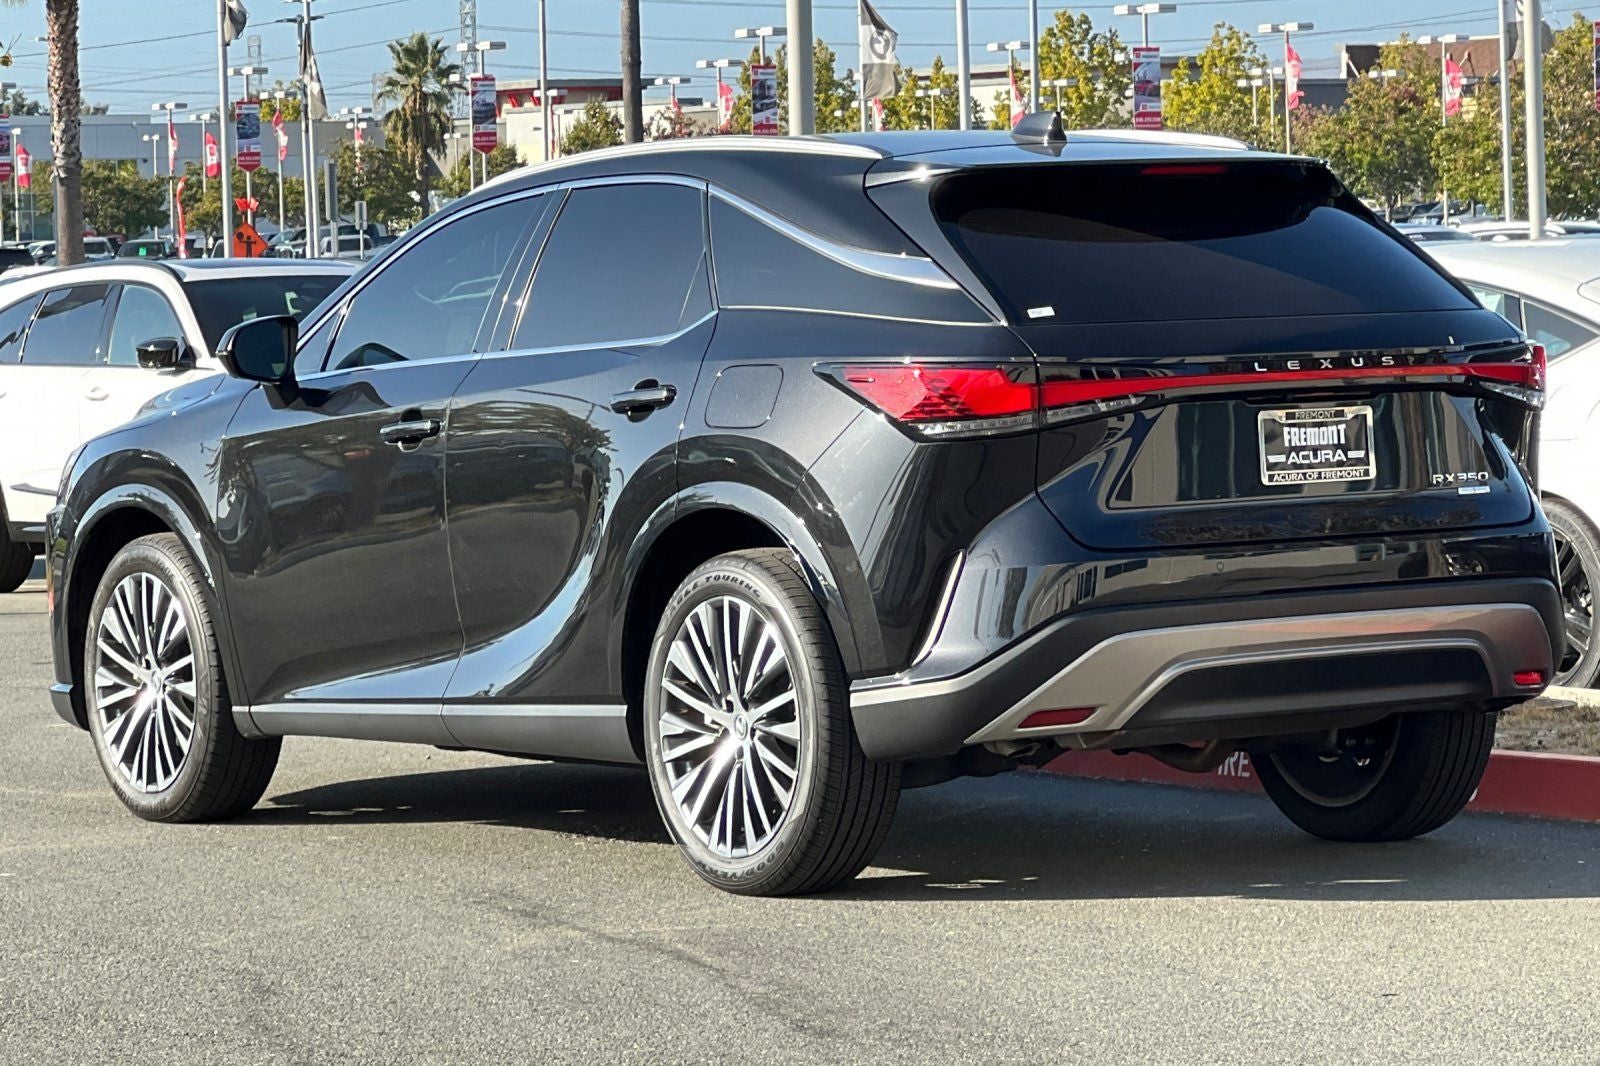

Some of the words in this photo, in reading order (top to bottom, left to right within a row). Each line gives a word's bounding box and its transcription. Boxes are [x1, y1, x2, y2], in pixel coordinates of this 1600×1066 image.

[1254, 356, 1395, 372] LEXUS
[1295, 410, 1335, 419] FREMONT
[1283, 424, 1347, 447] FREMONT
[1287, 449, 1347, 465] ACURA
[1273, 473, 1304, 483] ACURA
[1306, 472, 1319, 481] OF
[1321, 469, 1364, 480] FREMONT
[705, 574, 761, 598] TOURING
